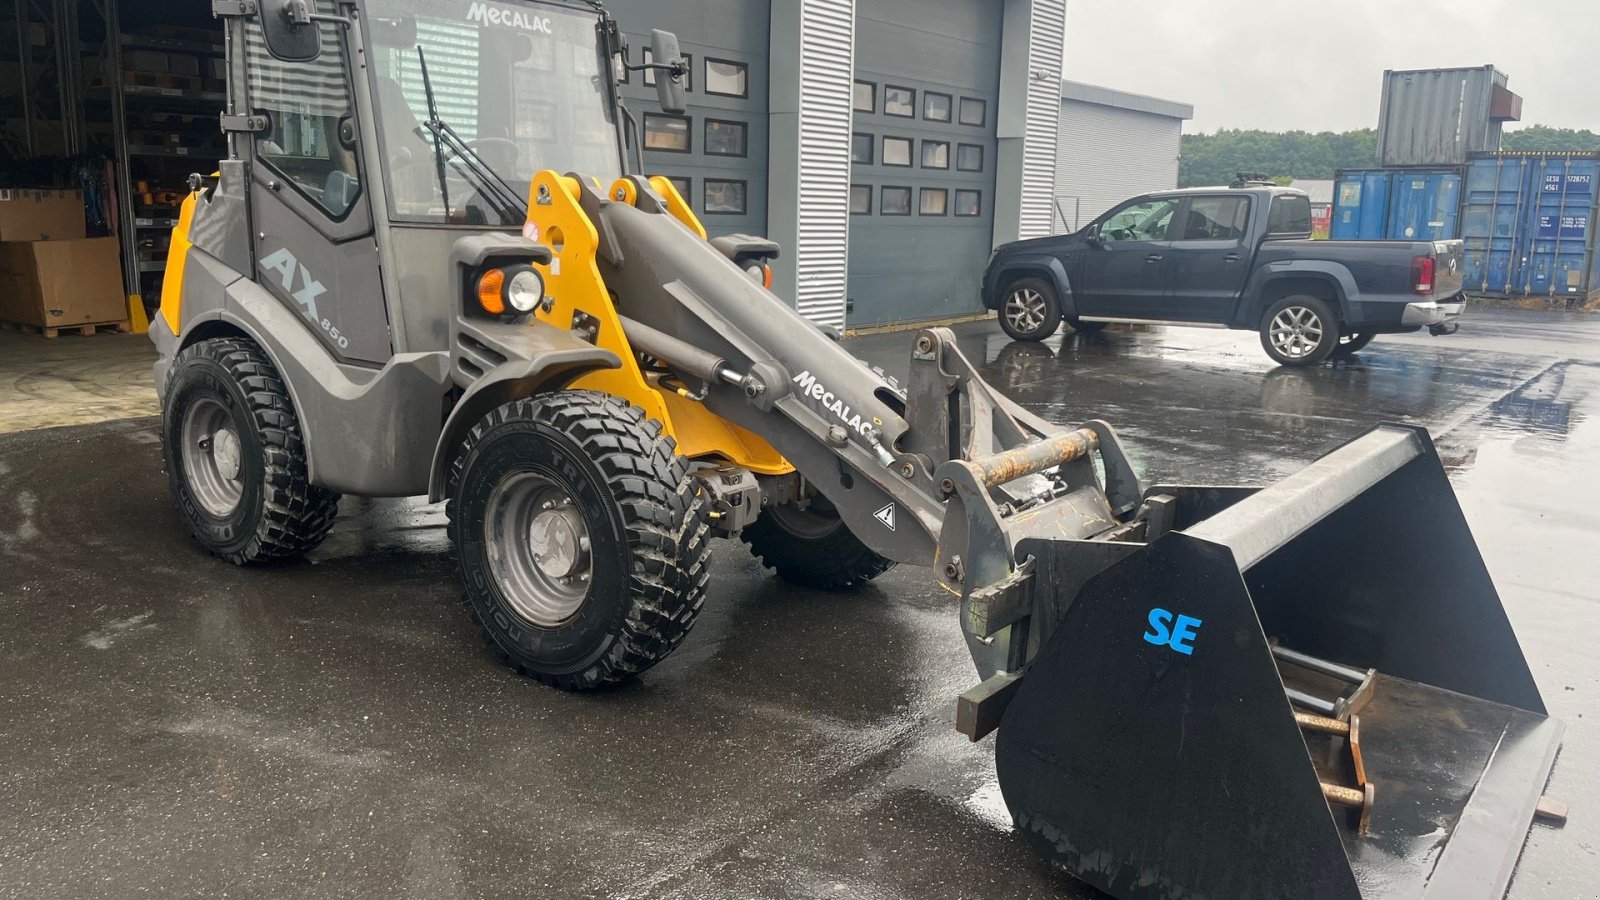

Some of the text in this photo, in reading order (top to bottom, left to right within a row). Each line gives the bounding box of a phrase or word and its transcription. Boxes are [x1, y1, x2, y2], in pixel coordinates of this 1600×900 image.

[259, 247, 328, 324] AX
[320, 318, 349, 349] 850
[1143, 607, 1203, 656] SE
